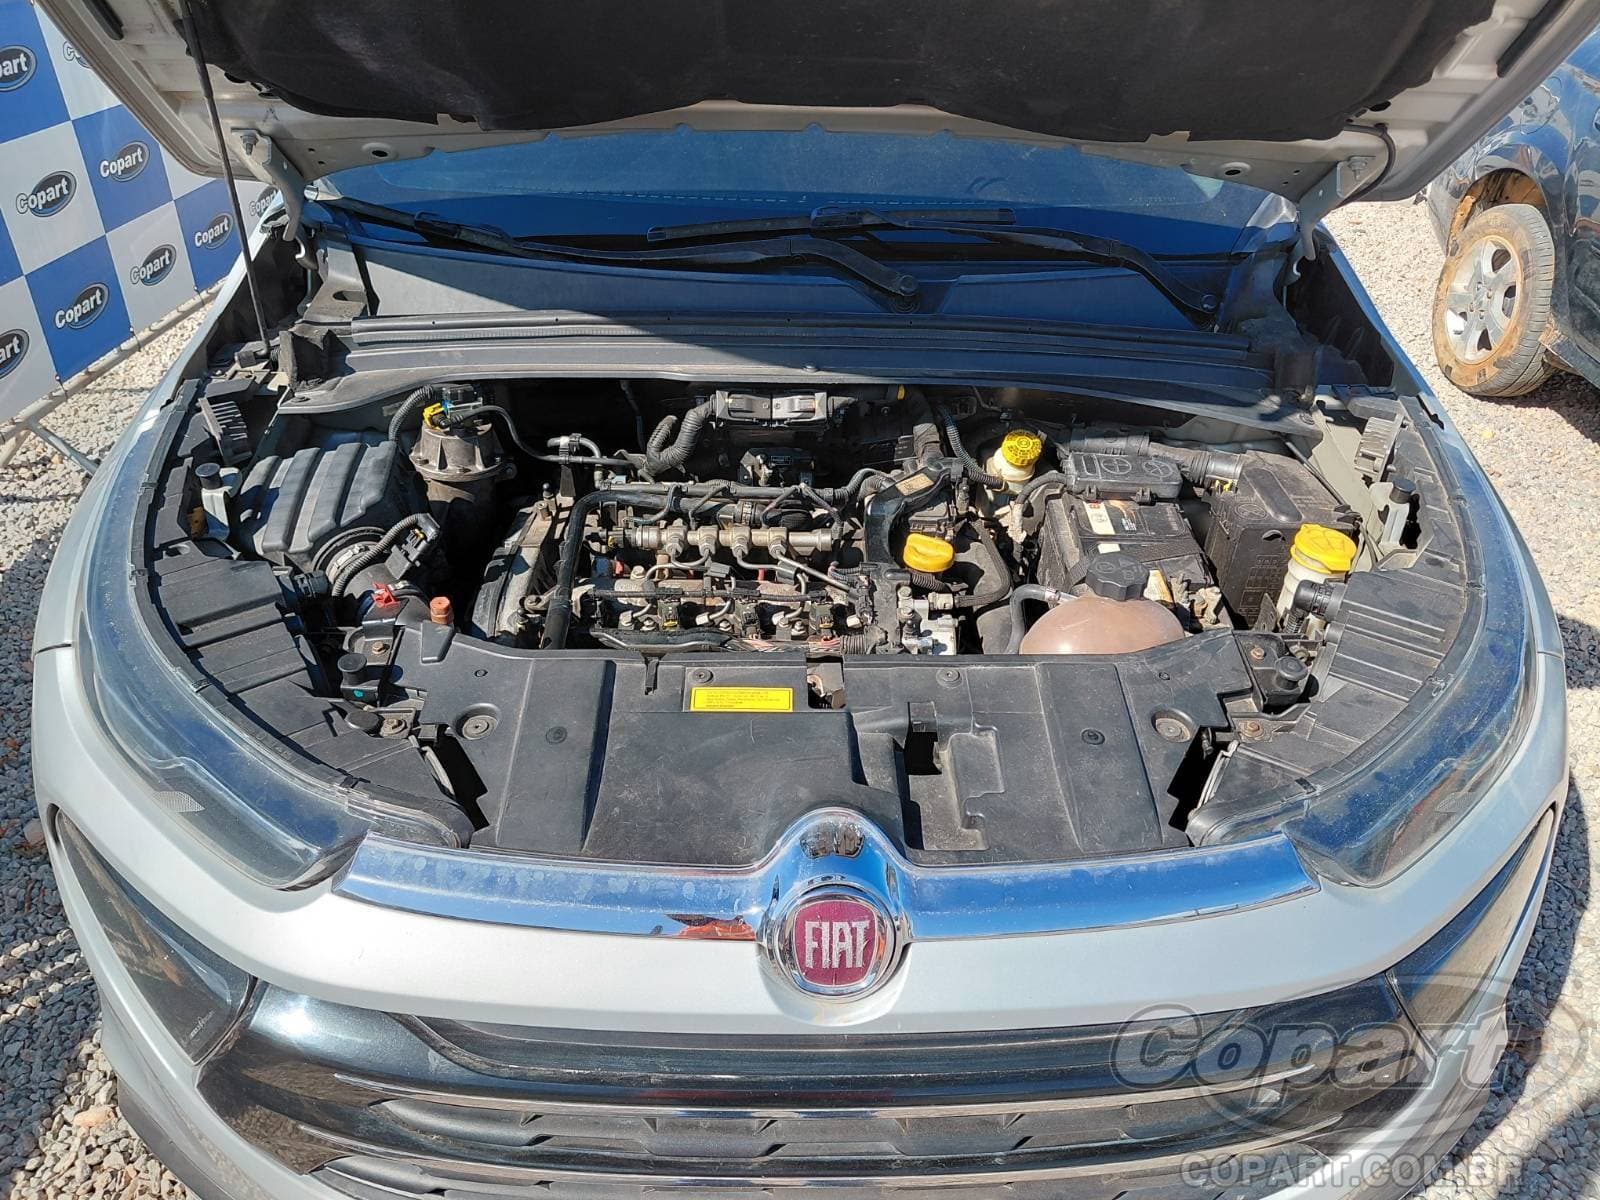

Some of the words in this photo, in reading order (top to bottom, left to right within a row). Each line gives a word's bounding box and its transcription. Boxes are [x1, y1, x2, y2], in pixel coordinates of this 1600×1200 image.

[0, 52, 28, 79] art
[100, 147, 143, 177] Copart
[16, 177, 69, 214] Copart
[194, 216, 229, 247] Copart
[131, 250, 171, 284] Copart
[55, 289, 102, 328] Copart
[804, 919, 870, 969] FIAT
